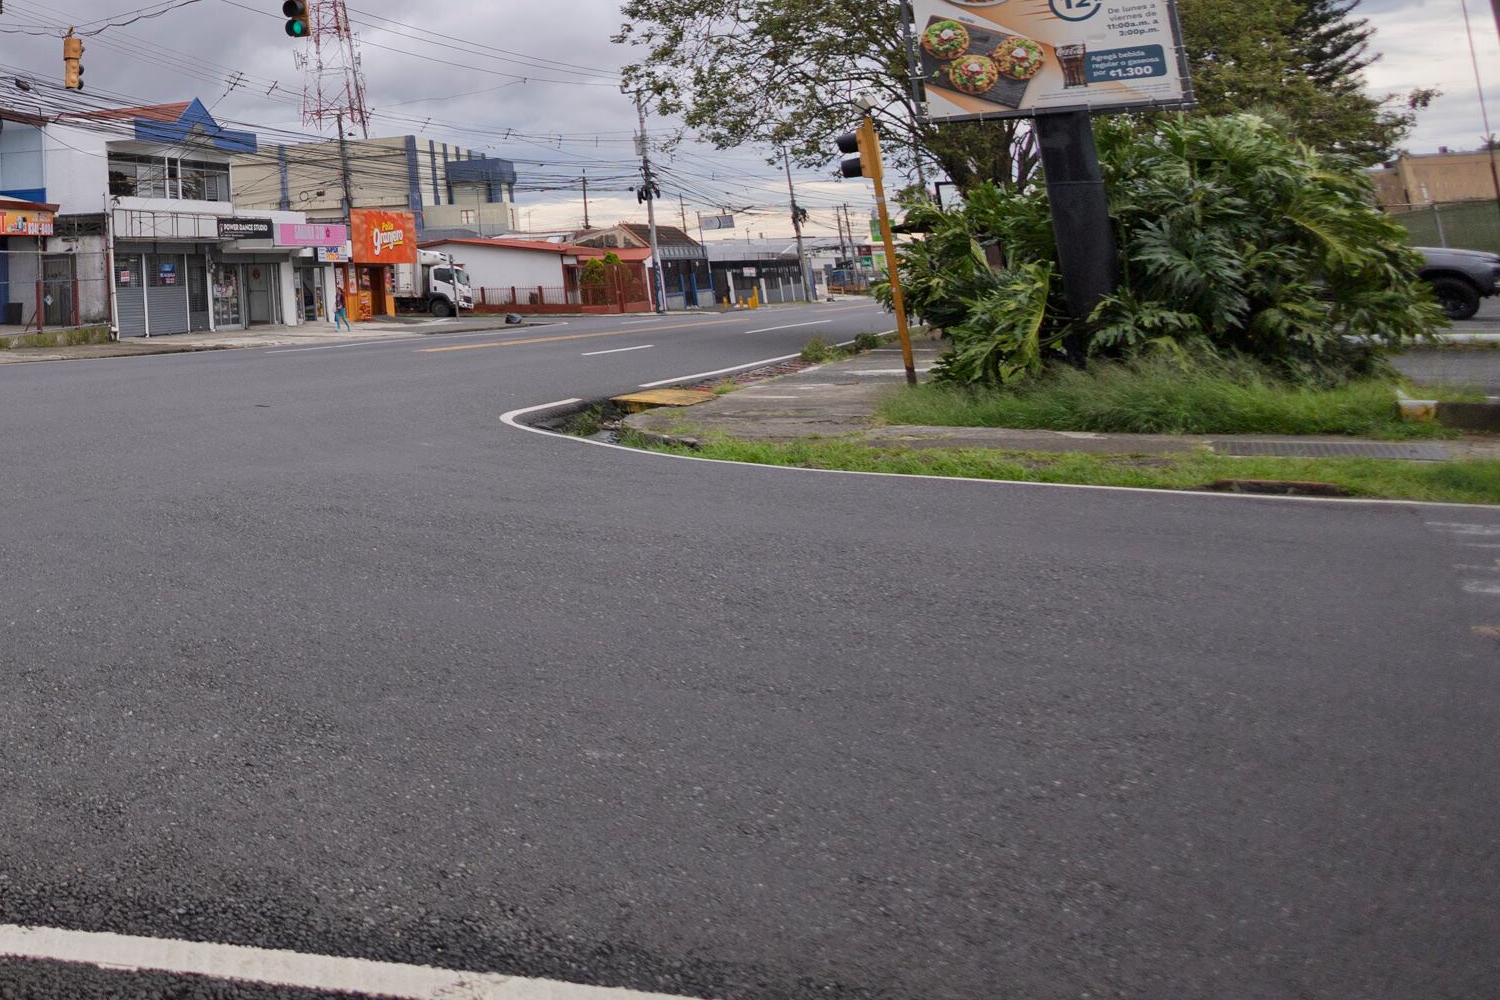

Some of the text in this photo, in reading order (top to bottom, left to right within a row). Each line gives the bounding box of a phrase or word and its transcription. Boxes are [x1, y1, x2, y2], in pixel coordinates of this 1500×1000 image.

[1122, 4, 1147, 13] lunes
[1109, 12, 1143, 22] viernes
[1118, 50, 1146, 59] bebida
[1092, 61, 1119, 69] regular
[223, 223, 239, 231] POWER
[239, 223, 253, 231] DANCE
[253, 224, 268, 232] STUDIO
